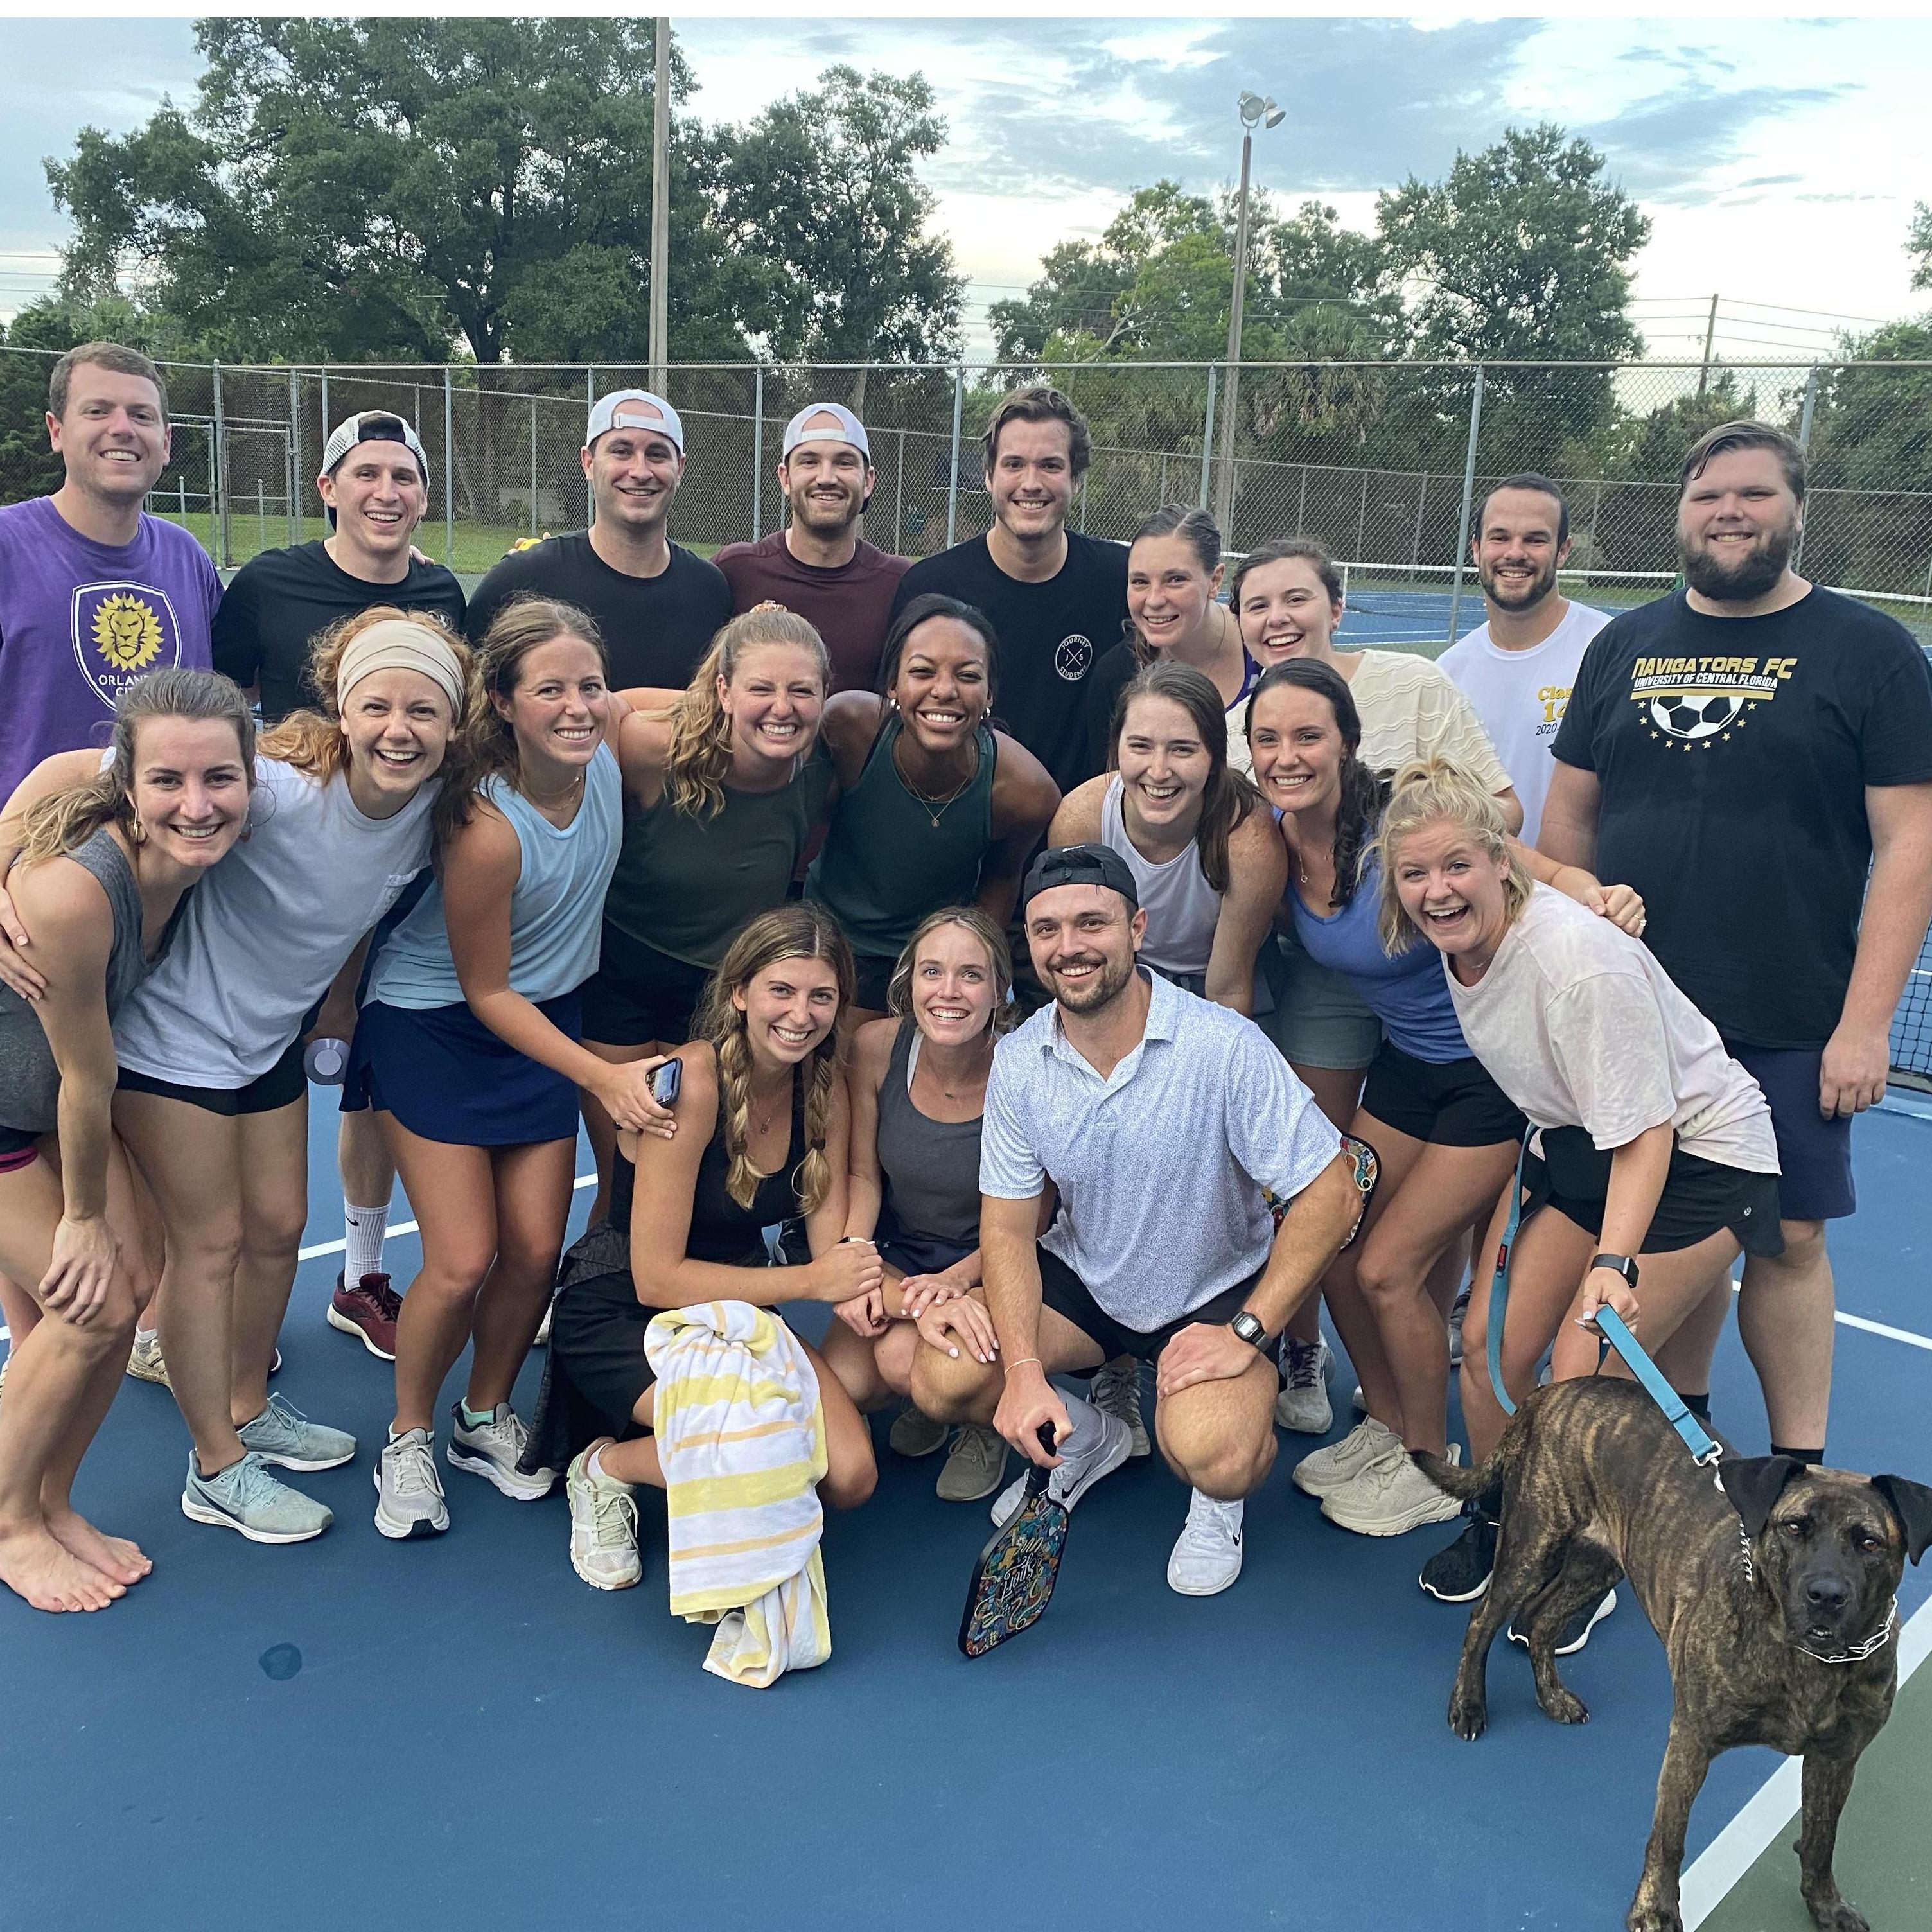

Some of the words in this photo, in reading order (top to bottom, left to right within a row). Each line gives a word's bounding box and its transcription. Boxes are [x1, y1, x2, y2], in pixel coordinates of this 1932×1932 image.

[1062, 637, 1089, 650] JOURNEY
[1631, 657, 1759, 680] NAVIGATORS
[1762, 658, 1798, 679] FC
[98, 674, 149, 685] ORLAN
[1634, 674, 1684, 688] UNIVERSITY
[1683, 673, 1696, 684] OF
[1696, 672, 1737, 685] CENTRAL
[1738, 674, 1778, 689] FLORIDA
